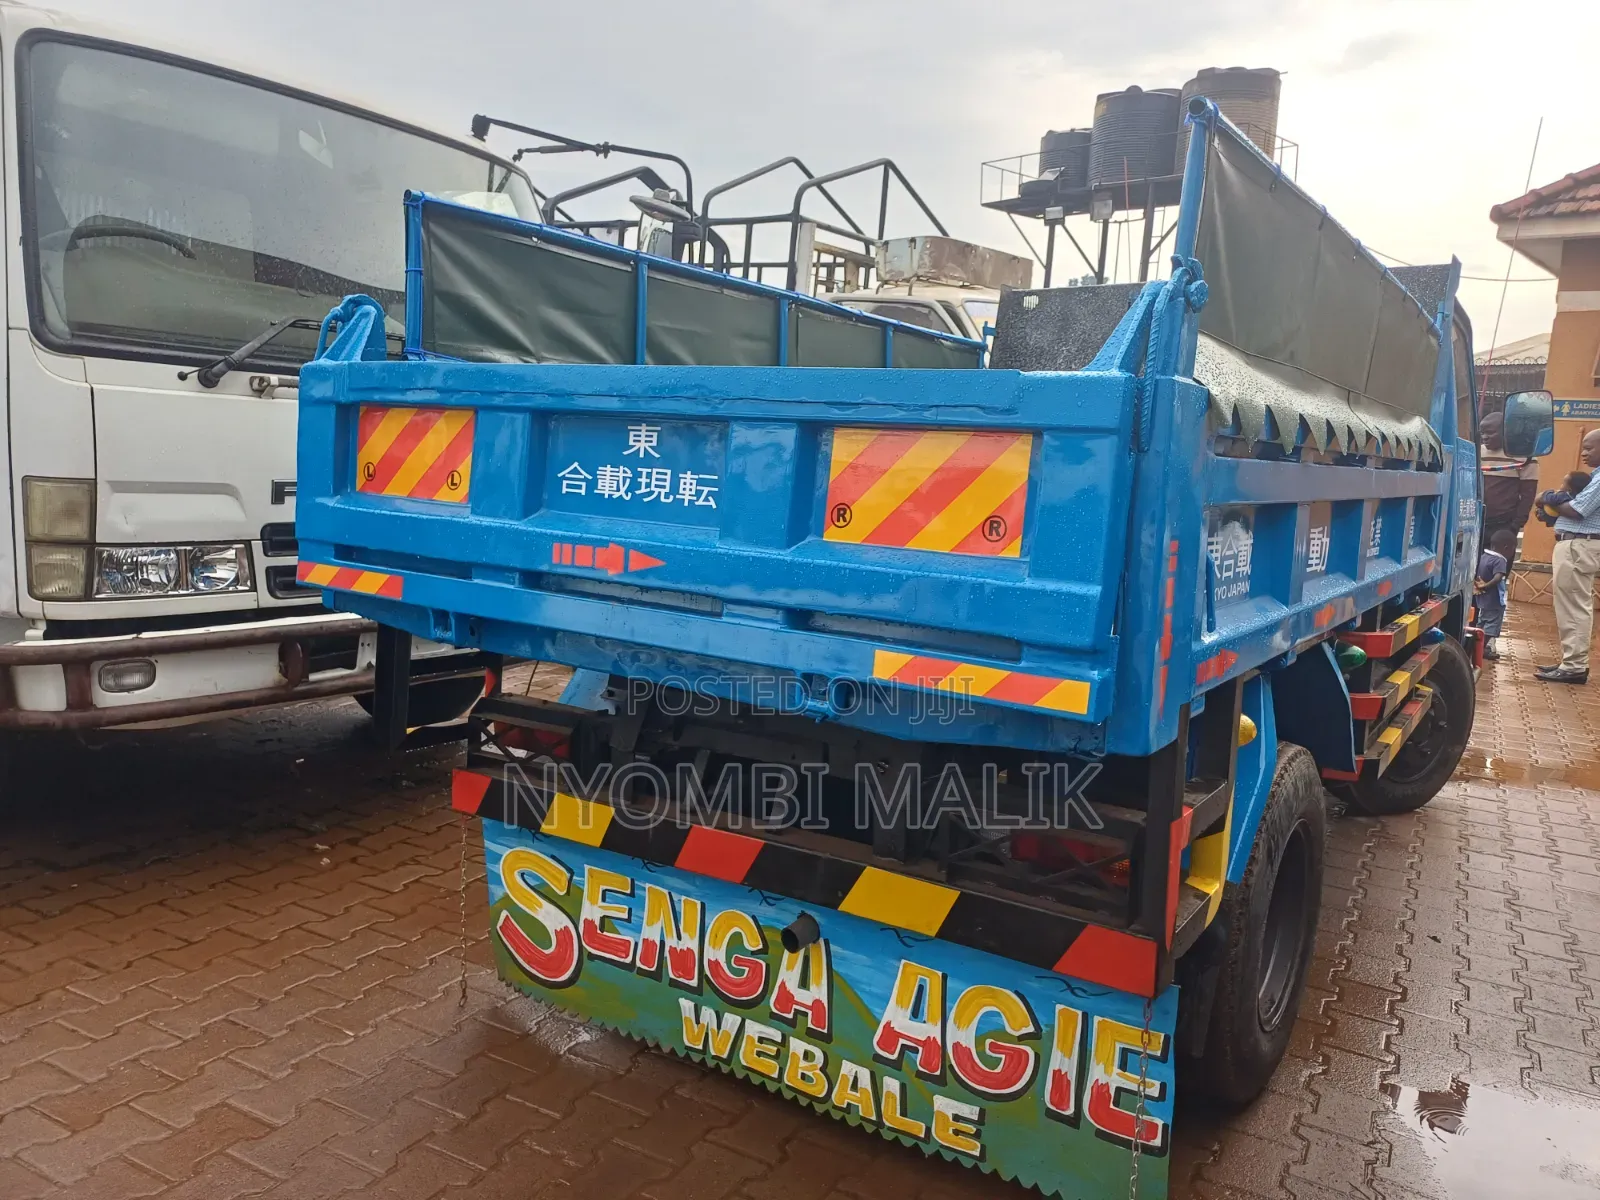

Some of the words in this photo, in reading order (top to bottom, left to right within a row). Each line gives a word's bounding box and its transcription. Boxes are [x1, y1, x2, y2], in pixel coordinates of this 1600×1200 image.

[622, 423, 662, 458] 東
[557, 461, 719, 509] 合載現転
[1227, 579, 1251, 598] JAPAN
[497, 847, 830, 1038] SENGA
[873, 959, 1168, 1152] AGIE
[679, 997, 984, 1159] WEBALE
